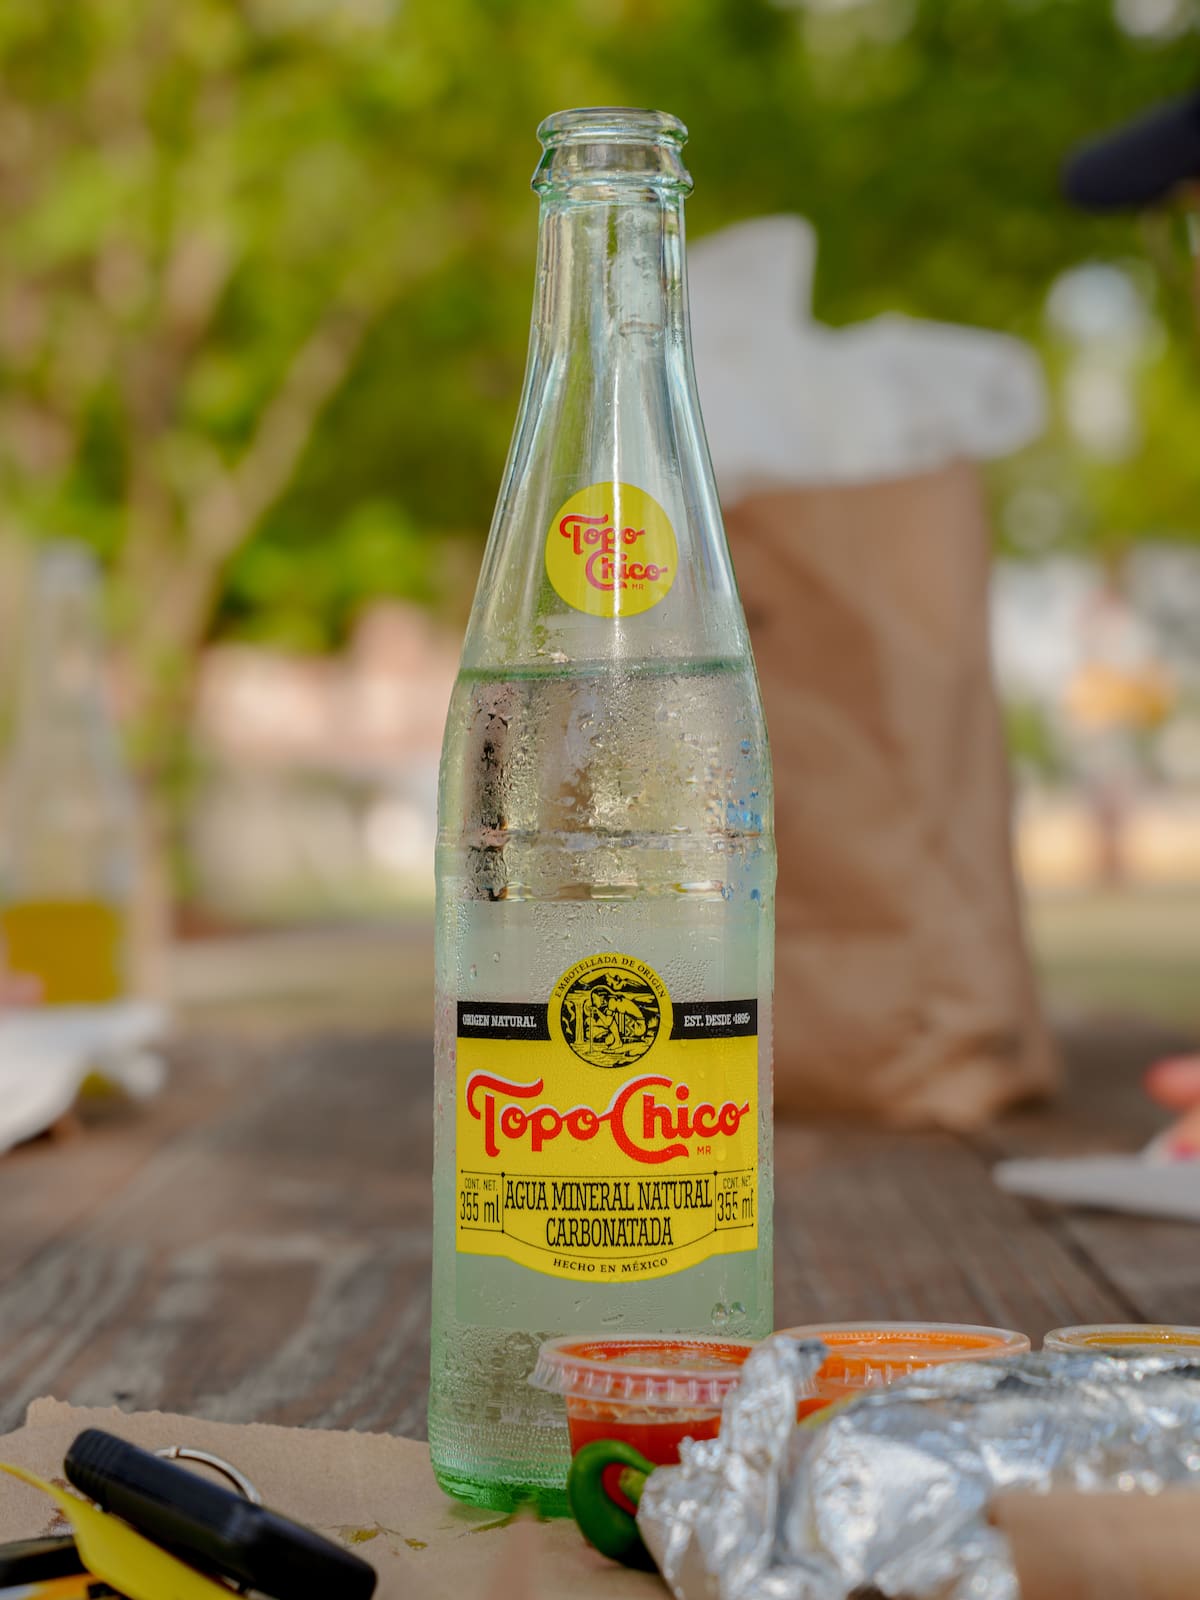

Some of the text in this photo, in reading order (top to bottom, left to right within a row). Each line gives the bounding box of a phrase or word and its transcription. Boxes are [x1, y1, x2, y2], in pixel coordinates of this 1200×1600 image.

[560, 514, 645, 555] Topo
[585, 549, 668, 591] Chico
[555, 956, 665, 997] EMBOTELLADA DE ORIGEN
[462, 1014, 537, 1027] ORIGEN NATURAL
[684, 1015, 704, 1027] EST.
[705, 1014, 732, 1026] DESDE
[466, 1070, 750, 1164] Topo Chico
[697, 1147, 711, 1155] MR
[464, 1178, 498, 1191] CONT. NET.
[504, 1179, 713, 1212] AGUA MINERAL NATURAL
[460, 1191, 500, 1224] 355 ml
[717, 1188, 754, 1222] 355 ml
[546, 1217, 673, 1248] CARBONATADA
[553, 1257, 669, 1273] HECHO EN MÉXICO
